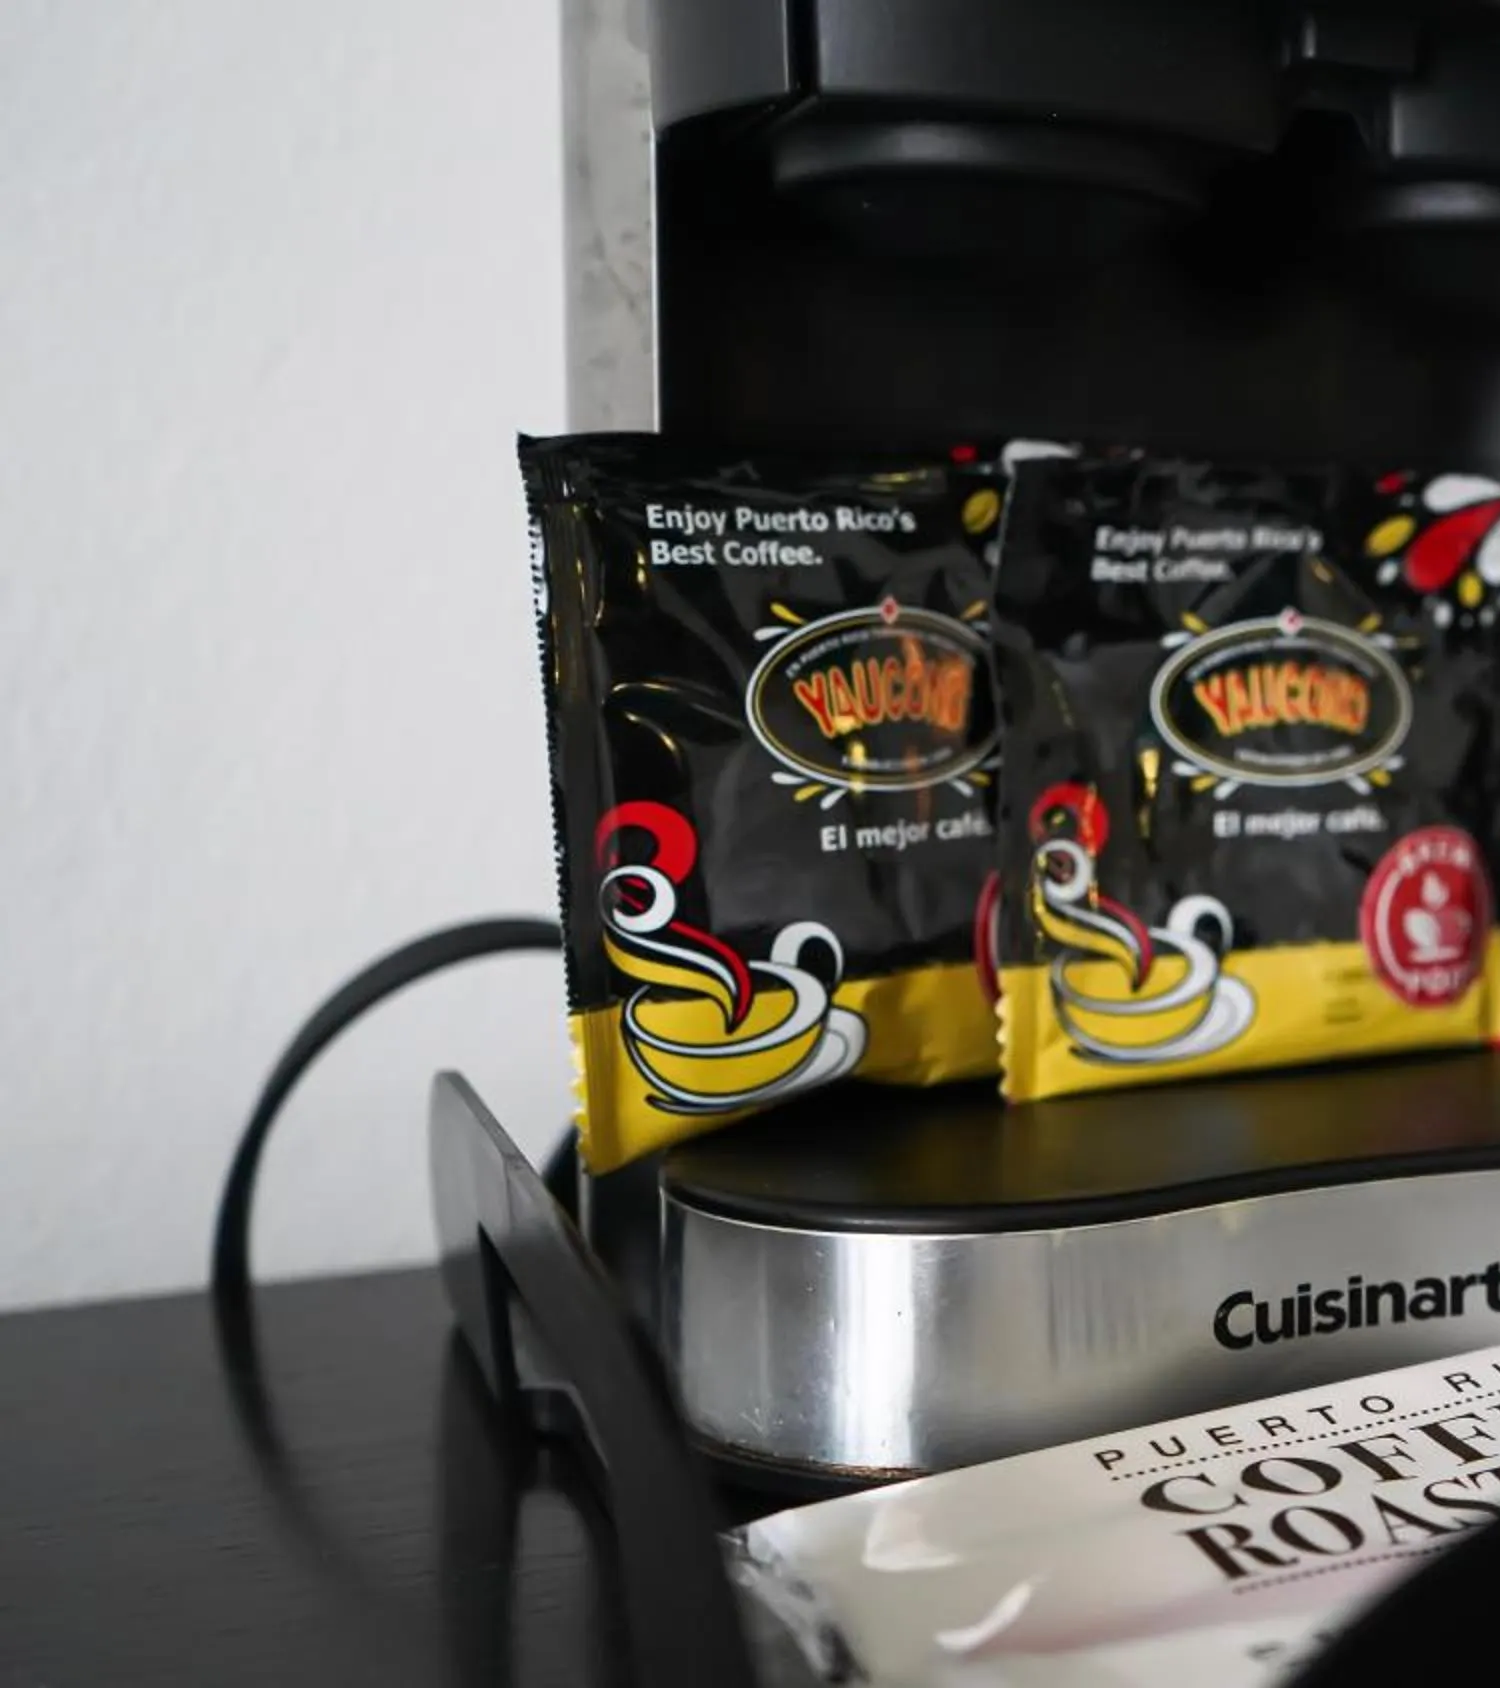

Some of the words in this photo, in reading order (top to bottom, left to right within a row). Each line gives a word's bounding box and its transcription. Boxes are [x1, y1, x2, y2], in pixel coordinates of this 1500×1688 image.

[646, 505, 727, 534] Enjoy
[736, 506, 829, 531] Puerto
[836, 507, 916, 532] Rico's
[651, 542, 716, 565] Best
[723, 540, 823, 566] Coffee.
[820, 824, 848, 851] El
[856, 818, 930, 851] mejor
[1092, 1394, 1396, 1472] PUERTO
